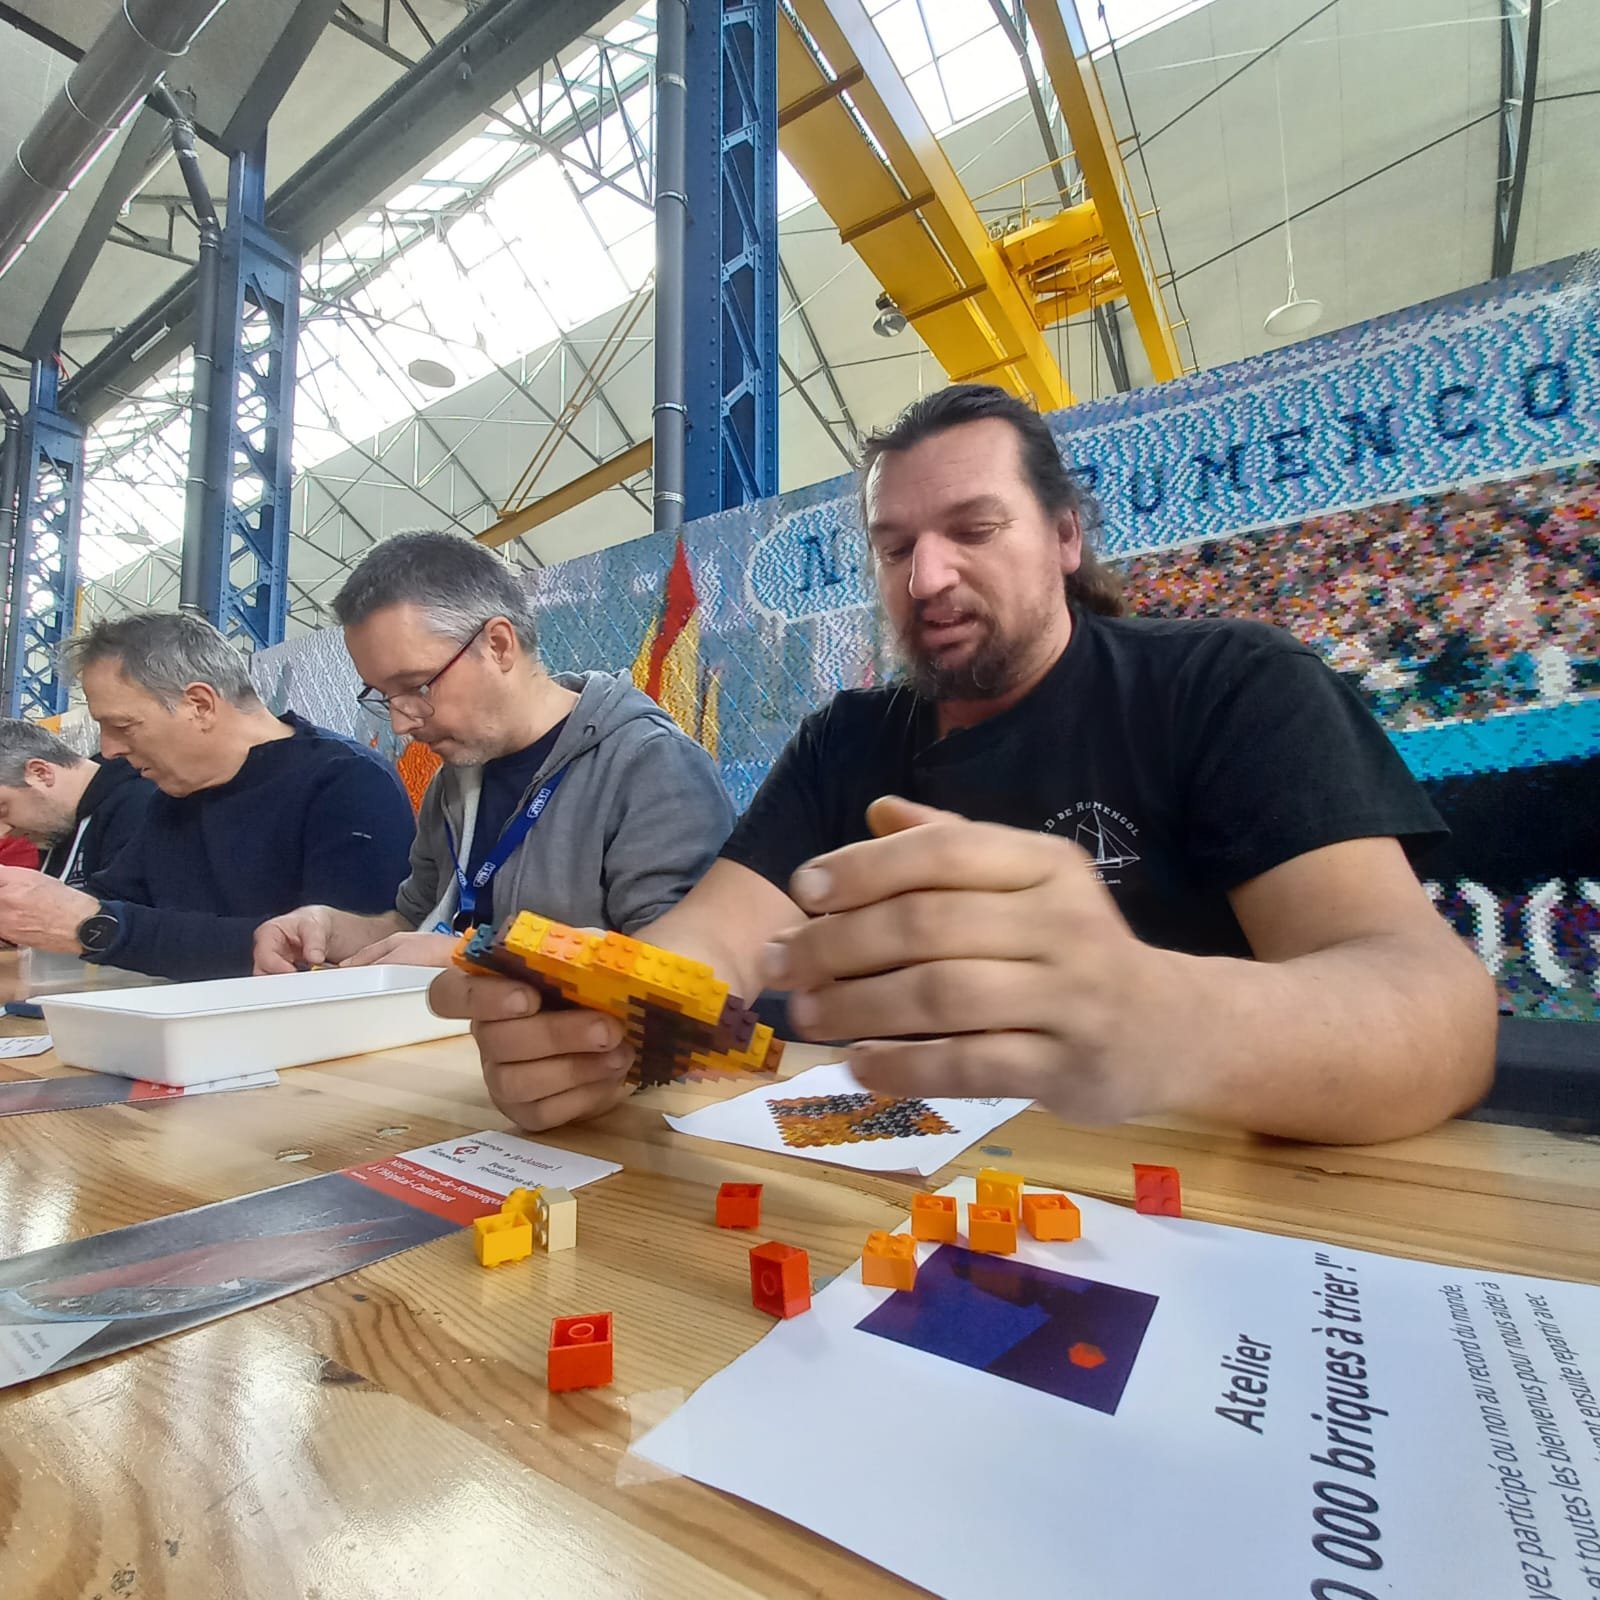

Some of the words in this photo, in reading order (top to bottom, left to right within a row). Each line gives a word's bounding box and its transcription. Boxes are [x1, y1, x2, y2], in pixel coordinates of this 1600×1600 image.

[1057, 808, 1073, 821] DE
[1312, 1272, 1363, 1323] trier
[1438, 1284, 1472, 1324] monde,
[1475, 1282, 1500, 1290] à
[1482, 1290, 1512, 1320] aider
[1525, 1292, 1554, 1320] avec
[1311, 1326, 1365, 1345] à
[1449, 1323, 1477, 1340] du
[1495, 1319, 1525, 1349] nous
[1533, 1319, 1580, 1367] repartir
[1453, 1338, 1491, 1384] record
[1507, 1348, 1548, 1385] pour
[1214, 1333, 1272, 1435] Atelier
[1472, 1384, 1499, 1404] au
[1560, 1366, 1600, 1418] ensuite
[1310, 1346, 1389, 1480] briques
[1479, 1405, 1510, 1437] non
[1520, 1382, 1572, 1462] bienvenus
[1489, 1438, 1518, 1462] ou
[1548, 1464, 1583, 1491] les
[1311, 1480, 1384, 1571] 000
[1487, 1463, 1556, 1560] participé
[1561, 1493, 1600, 1560] toutes
